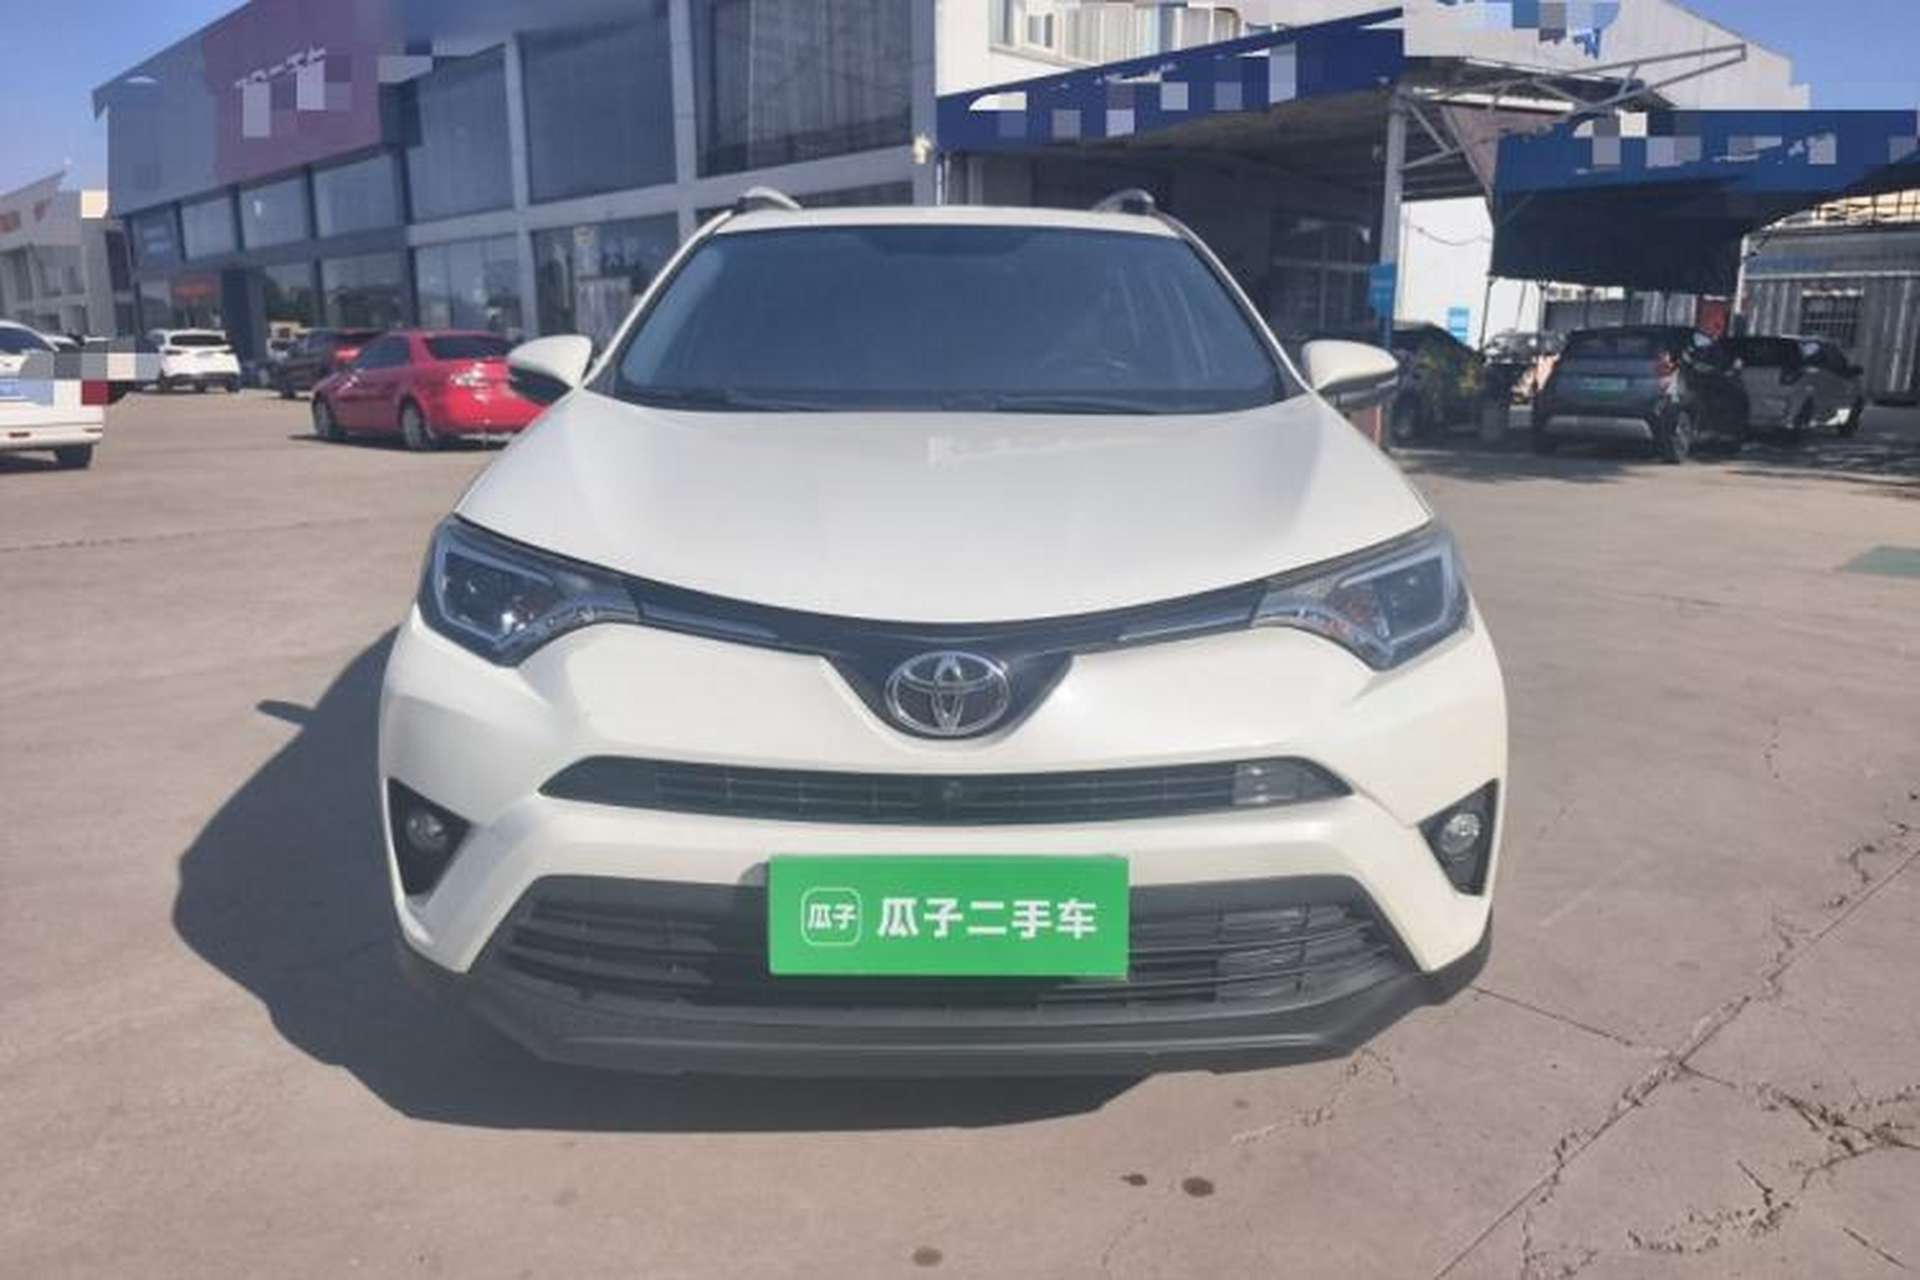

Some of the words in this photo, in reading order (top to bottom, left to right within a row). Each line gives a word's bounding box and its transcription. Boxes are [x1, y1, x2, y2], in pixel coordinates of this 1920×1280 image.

[808, 903, 857, 931] 瓜子
[877, 897, 1097, 939] 瓜子二手车
